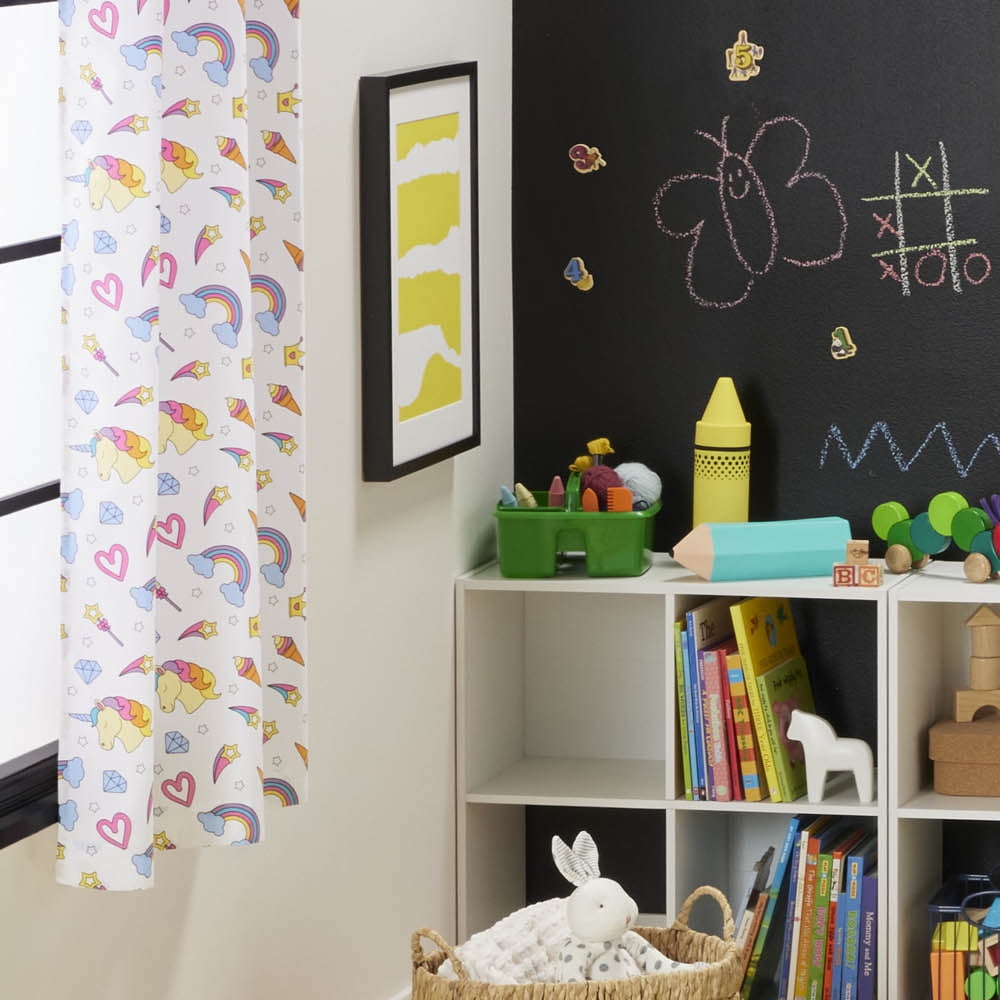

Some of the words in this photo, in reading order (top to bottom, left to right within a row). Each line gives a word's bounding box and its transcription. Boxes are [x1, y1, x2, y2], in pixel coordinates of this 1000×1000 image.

[736, 45, 752, 69] 5
[566, 259, 583, 282] 4
[838, 569, 851, 583] B
[863, 570, 876, 584] C
[804, 884, 813, 907] Giraffe
[863, 911, 873, 946] Mommy
[863, 962, 872, 977] Me
